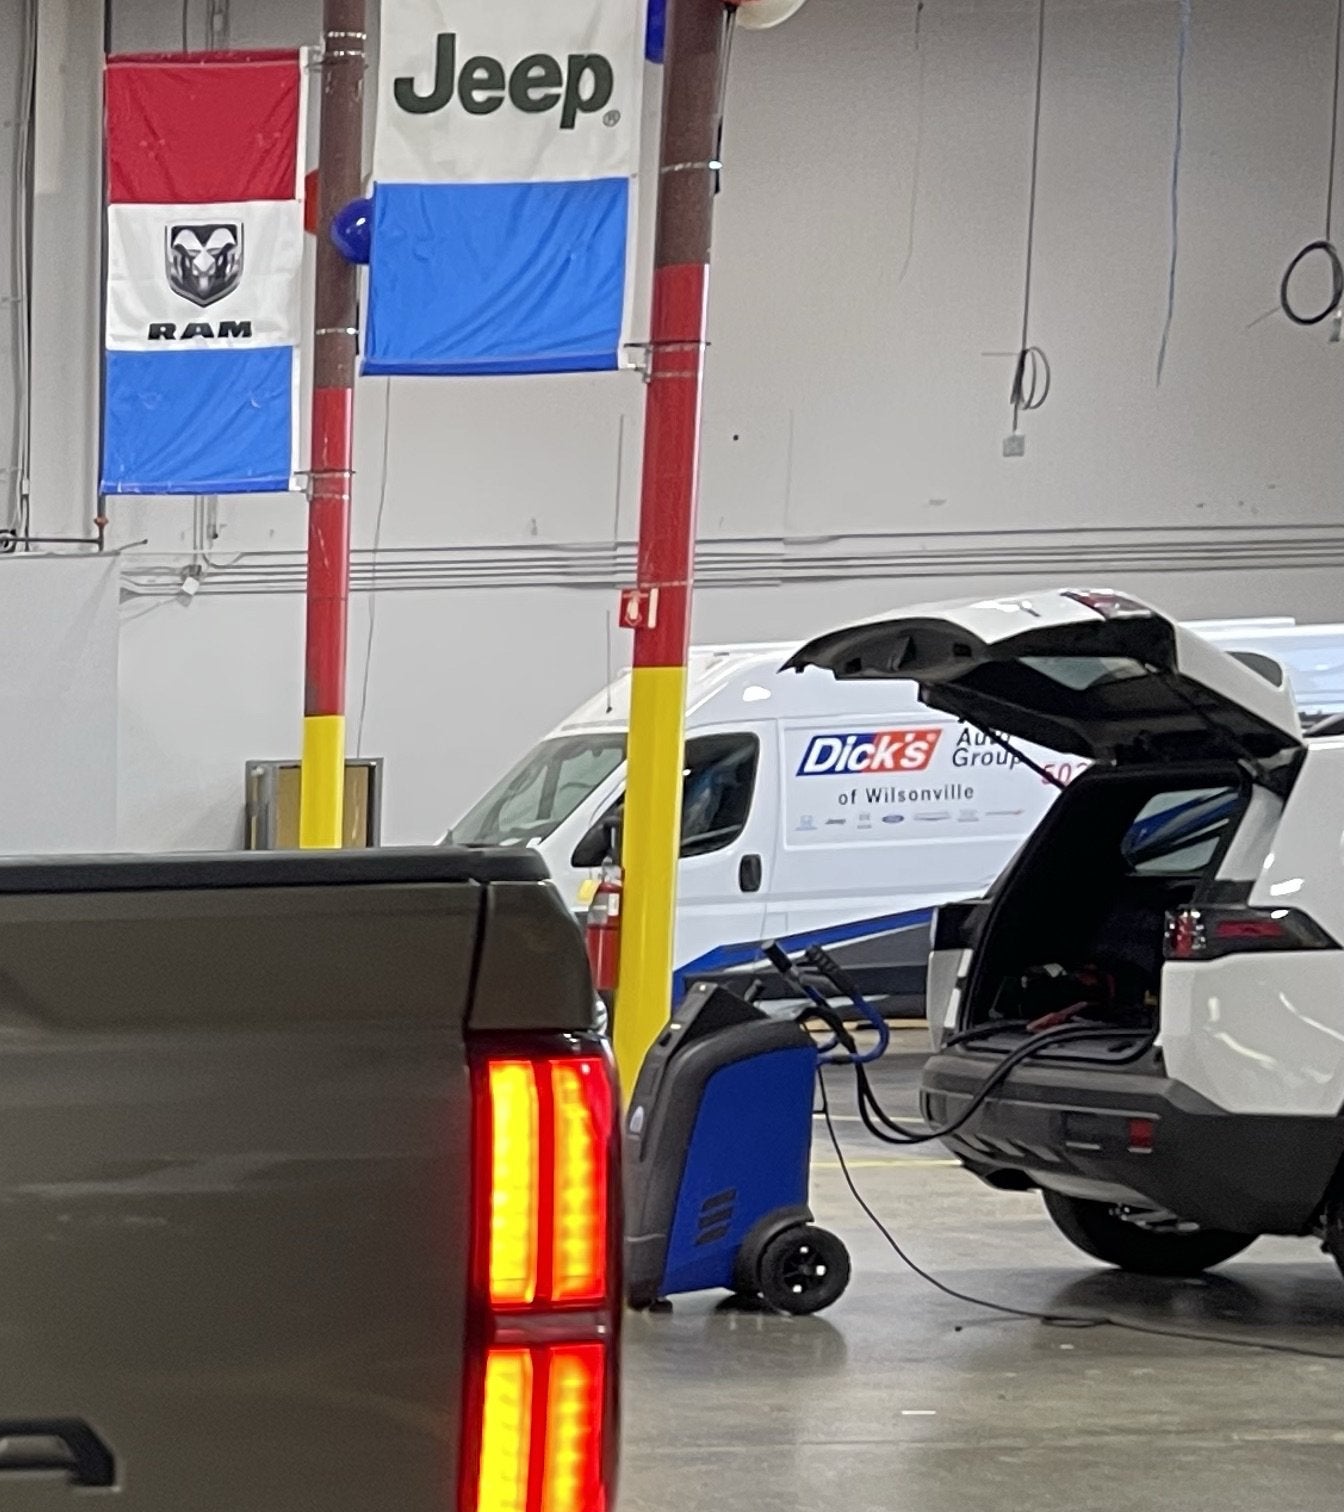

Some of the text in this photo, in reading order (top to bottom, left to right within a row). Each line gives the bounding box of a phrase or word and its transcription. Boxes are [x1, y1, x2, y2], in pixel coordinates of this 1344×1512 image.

[394, 32, 614, 129] Jeep
[147, 320, 253, 340] RAM
[952, 747, 1021, 770] Group
[838, 784, 974, 805] of Wilsonville
